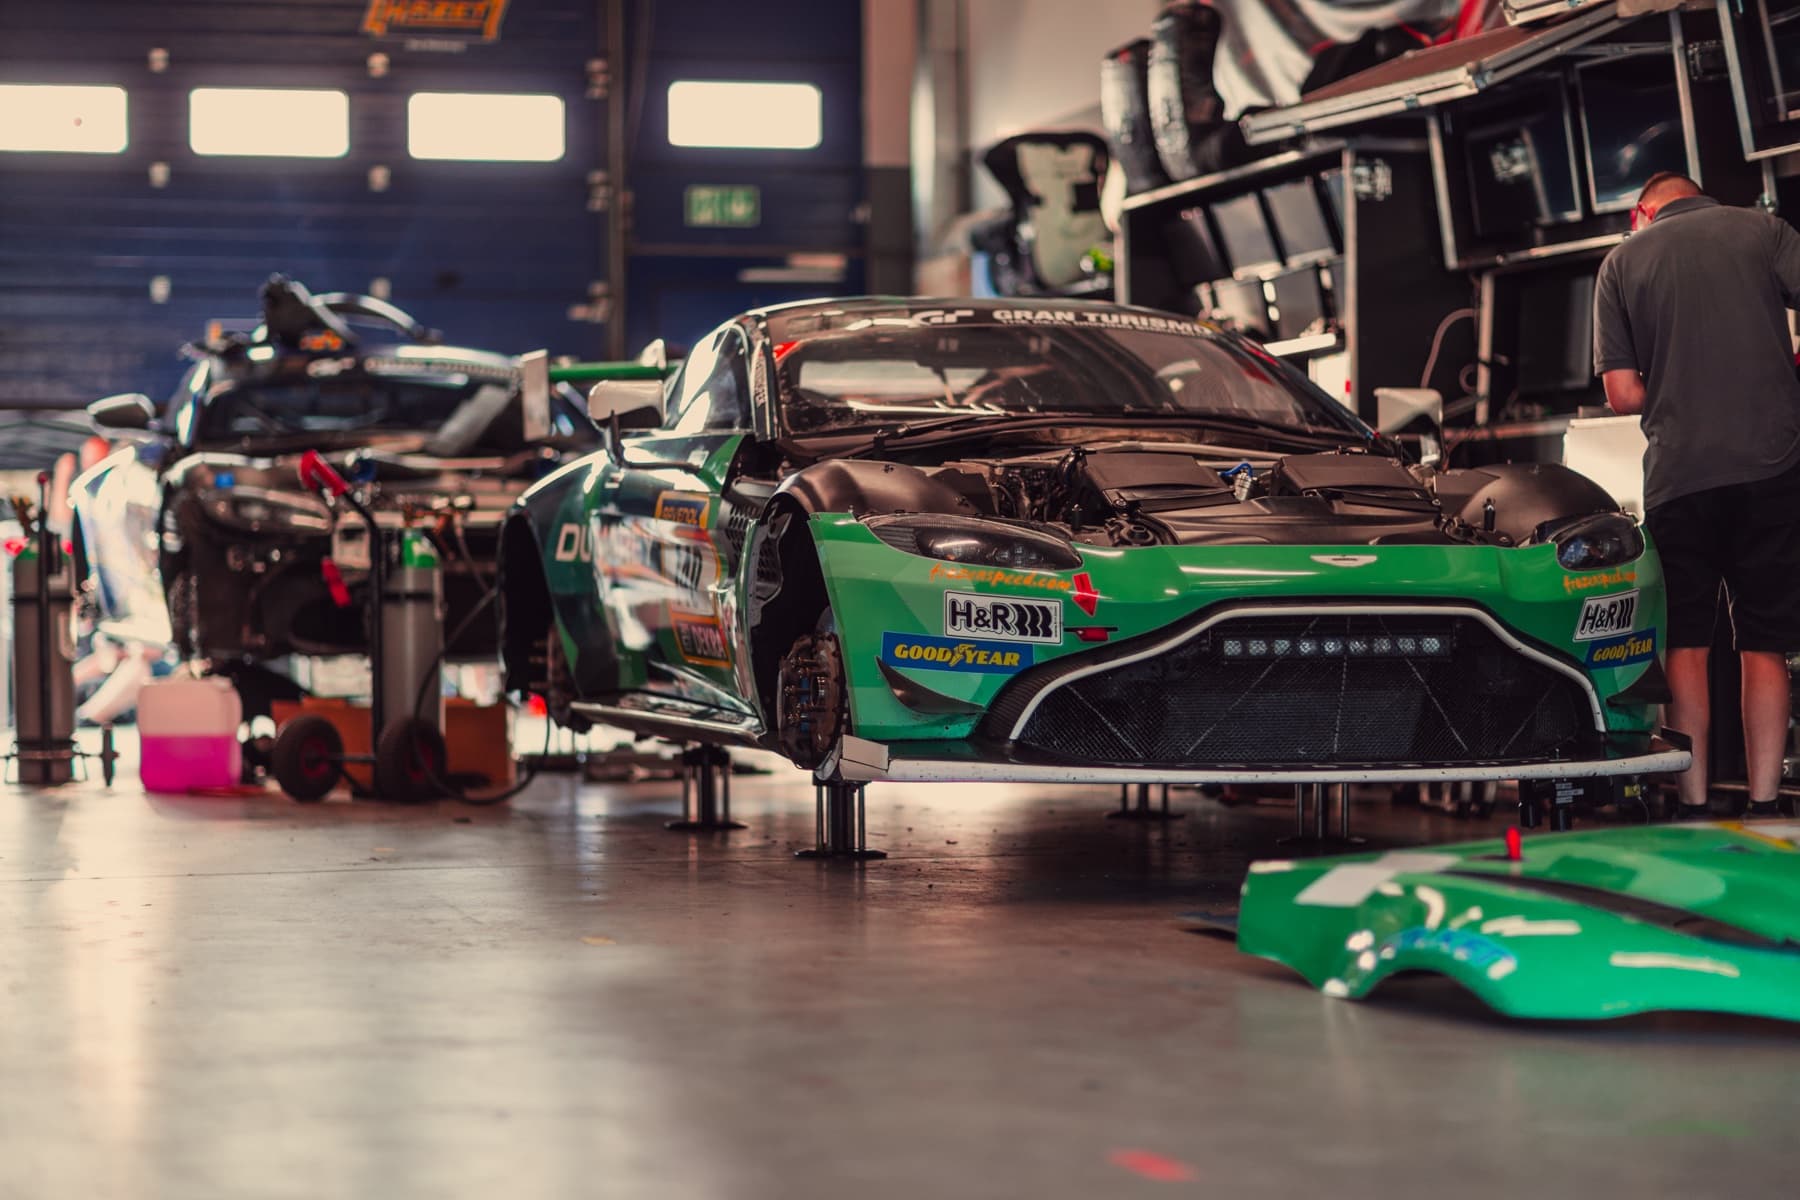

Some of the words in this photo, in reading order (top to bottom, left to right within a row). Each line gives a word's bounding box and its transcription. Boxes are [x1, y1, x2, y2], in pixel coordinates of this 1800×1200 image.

[993, 310, 1075, 322] GRAN
[1082, 313, 1212, 334] TURISMO
[950, 599, 1016, 635] H&R
[1581, 602, 1618, 634] H&R
